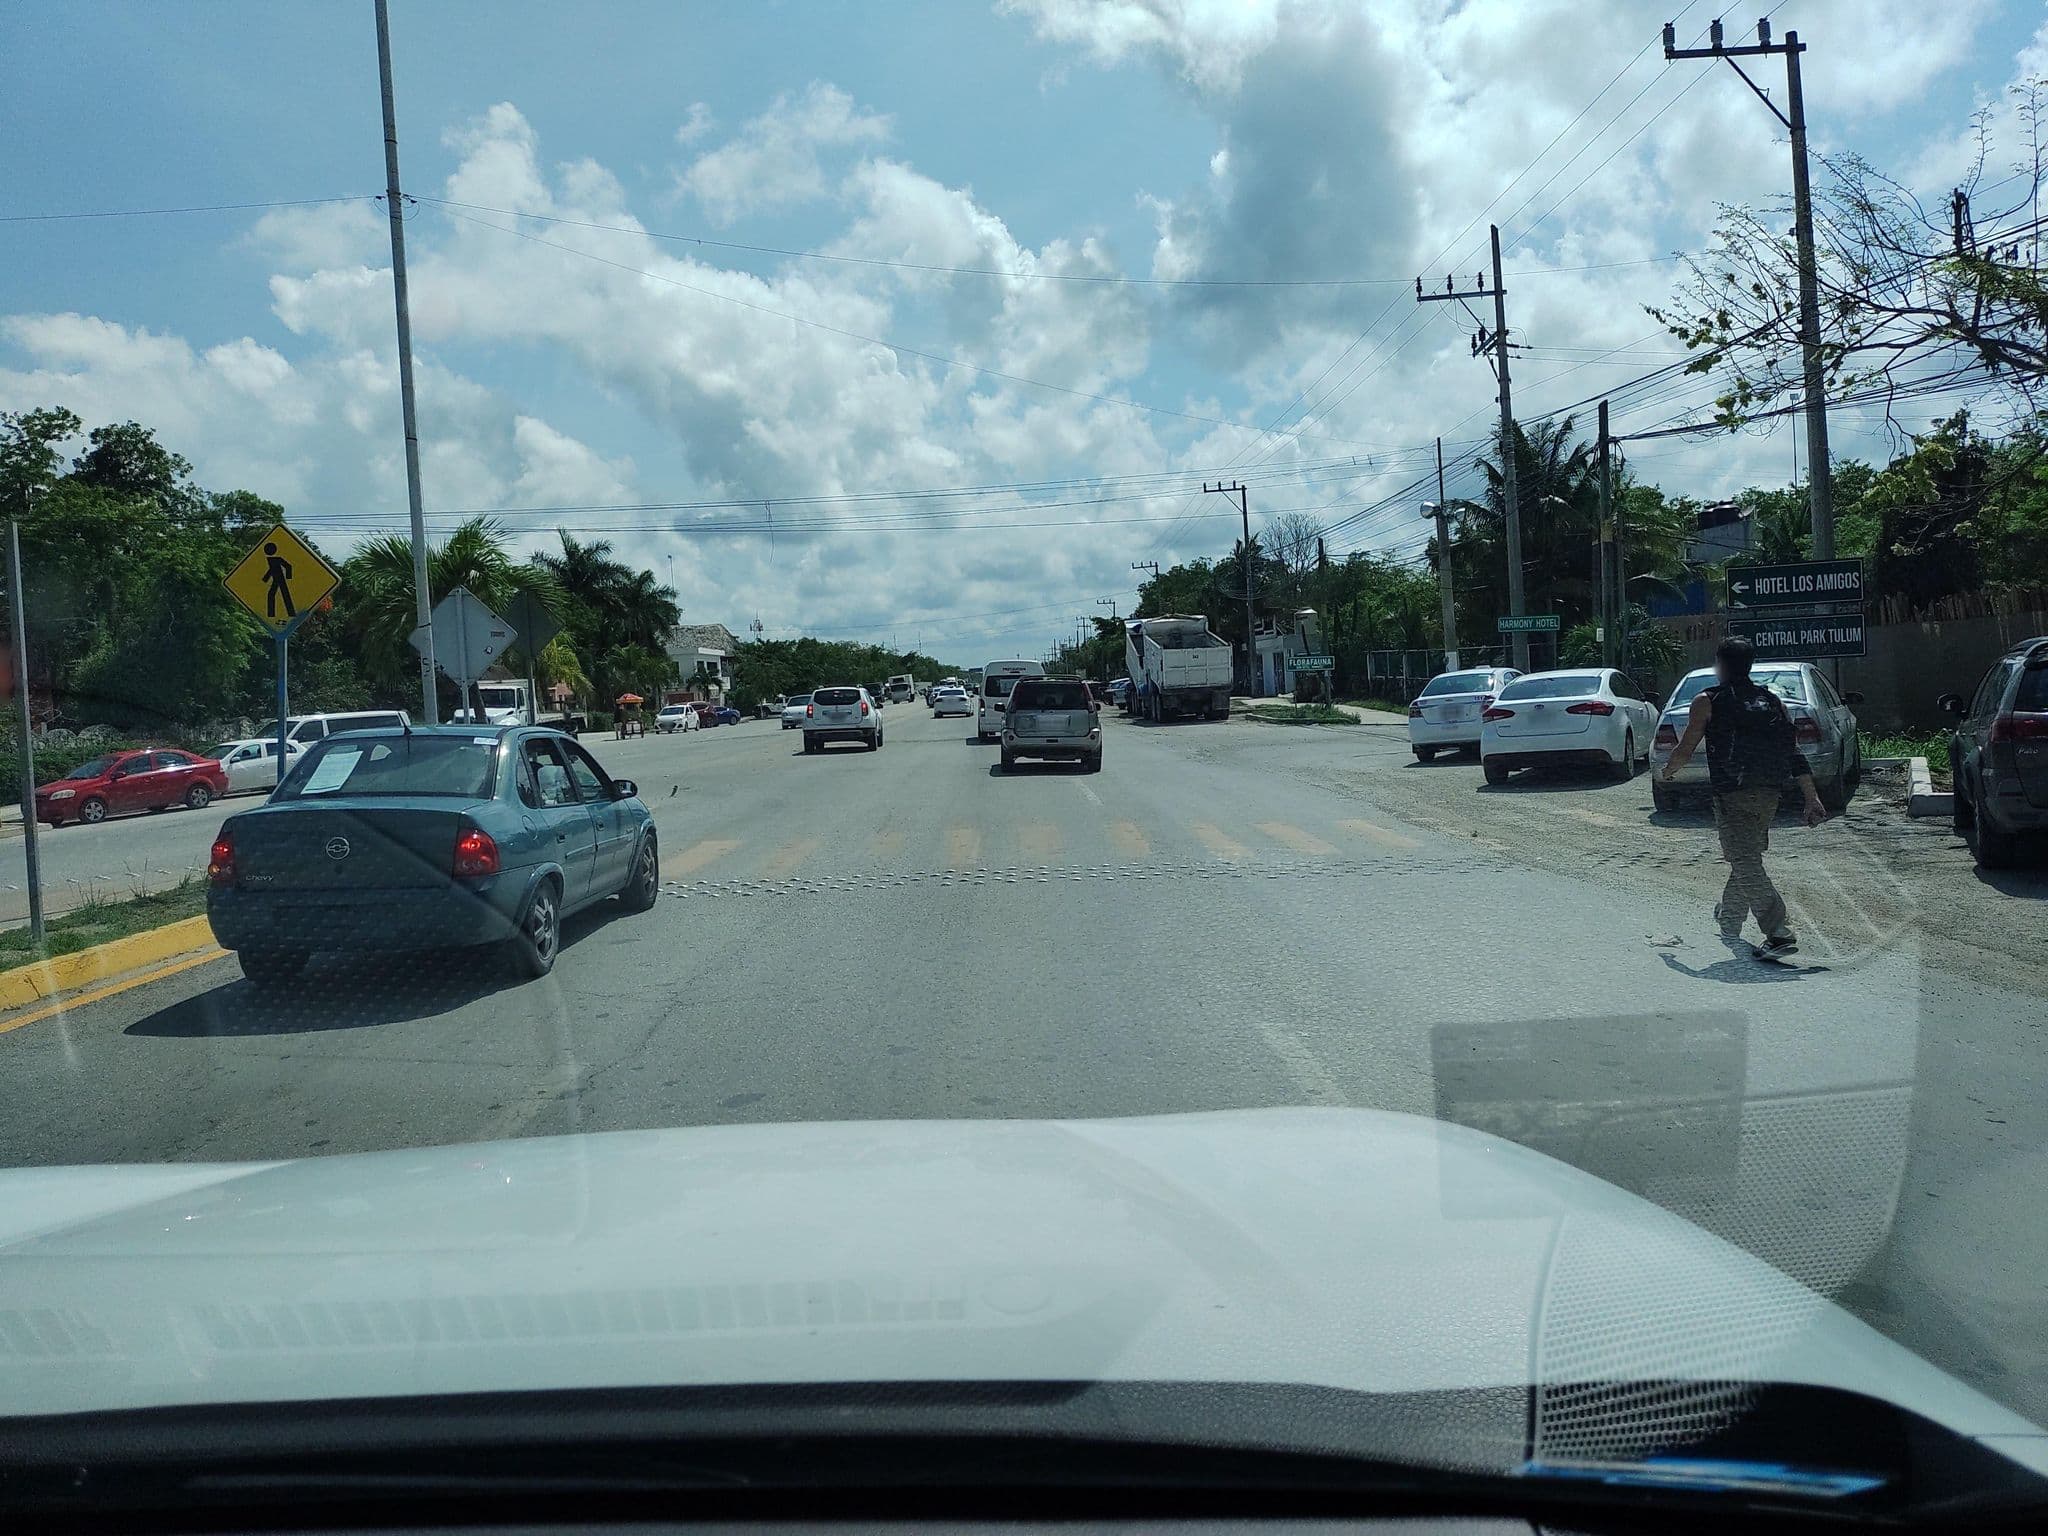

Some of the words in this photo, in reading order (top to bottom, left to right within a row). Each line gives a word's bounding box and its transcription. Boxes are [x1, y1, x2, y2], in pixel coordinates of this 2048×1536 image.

[1755, 576, 1790, 595] HOTEL
[1792, 575, 1813, 593] LOS
[1816, 572, 1860, 591] AMIGOS
[1499, 619, 1533, 629] HARMONY
[1536, 618, 1558, 628] HOTEL
[1755, 631, 1799, 647] CENTRAL
[1800, 629, 1827, 645] PARK
[1828, 627, 1862, 643] TULUM
[1289, 658, 1332, 666] FLORAFAUNA
